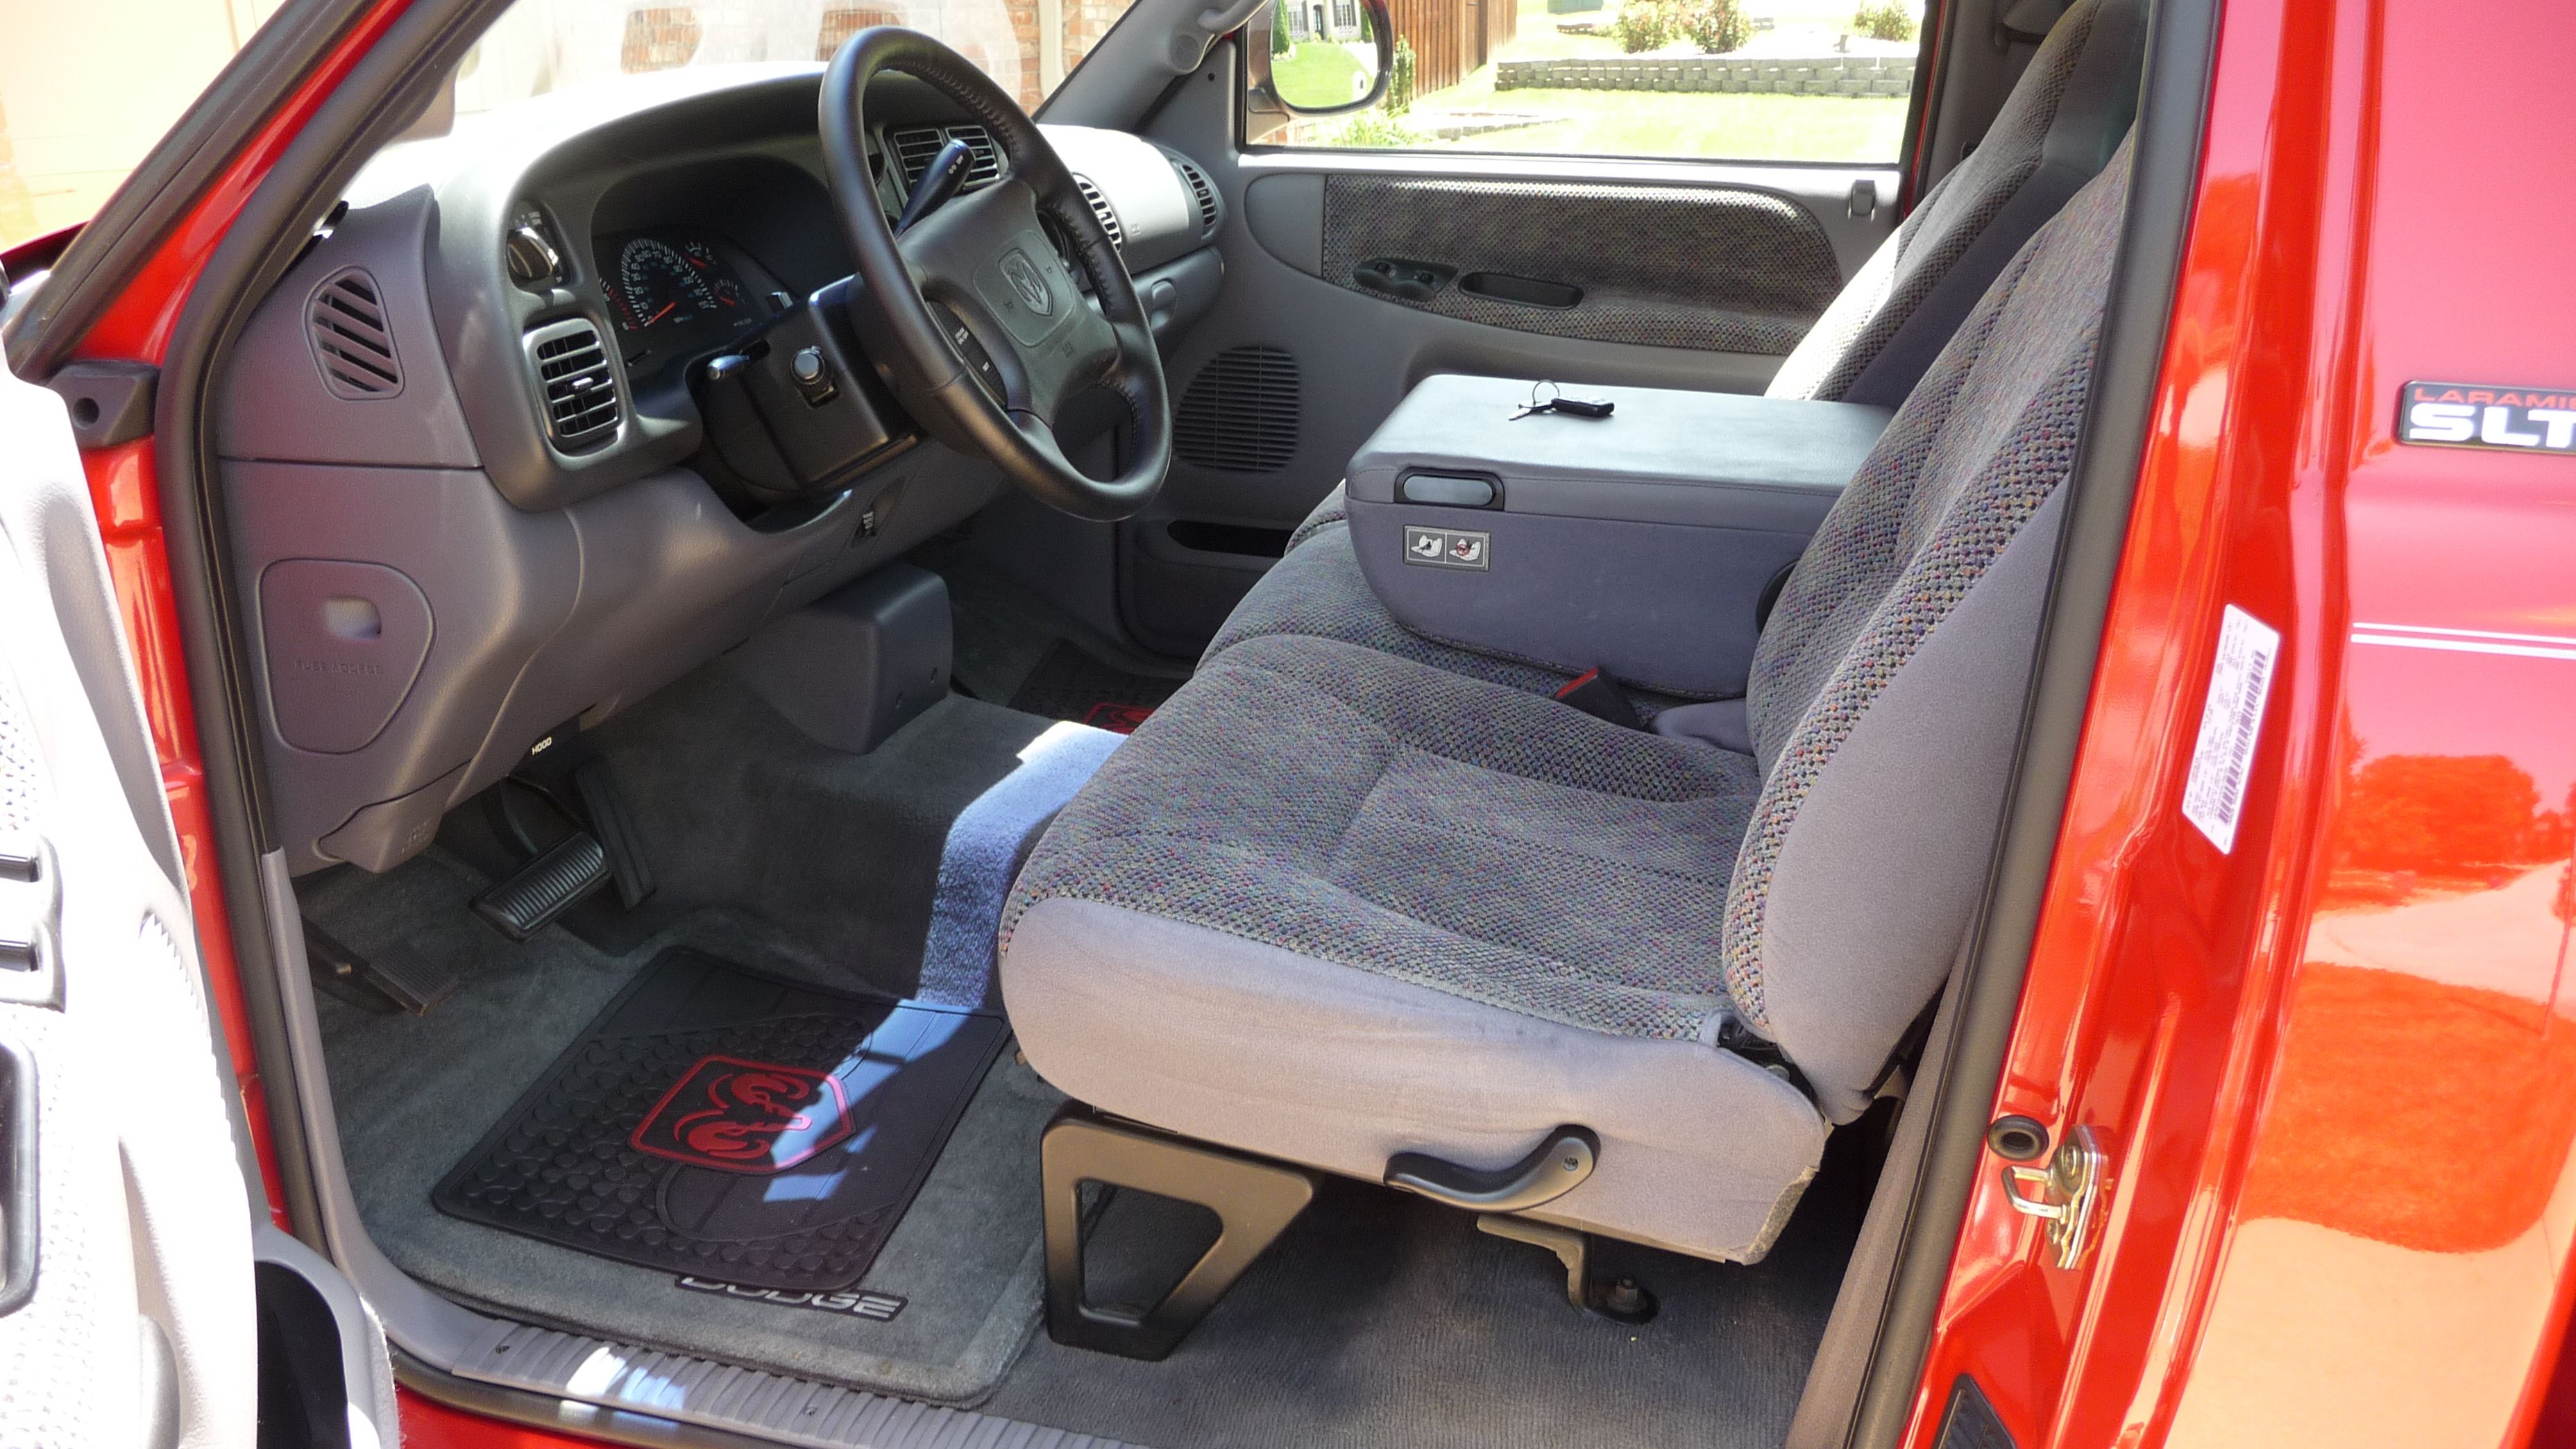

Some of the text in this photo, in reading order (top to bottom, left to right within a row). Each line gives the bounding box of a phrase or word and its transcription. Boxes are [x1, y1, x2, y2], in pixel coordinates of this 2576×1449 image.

[2414, 388, 2576, 409] LARAMI
[2409, 402, 2576, 448] SLT
[532, 736, 552, 755] HOOD
